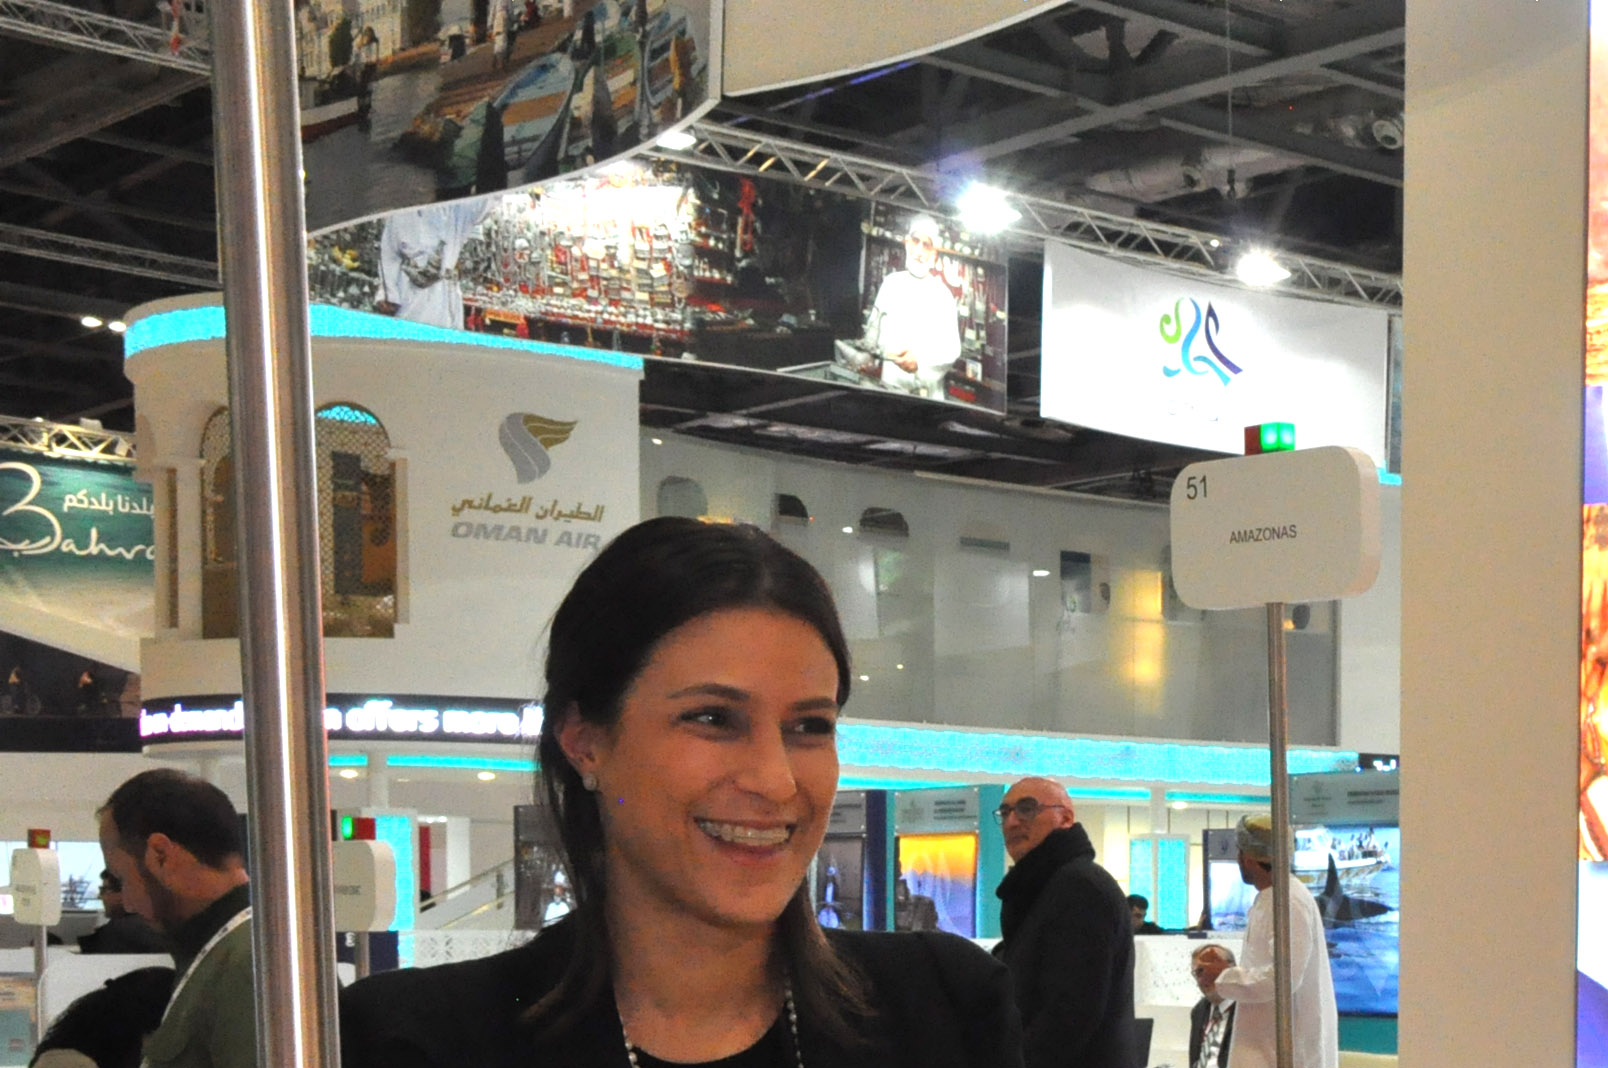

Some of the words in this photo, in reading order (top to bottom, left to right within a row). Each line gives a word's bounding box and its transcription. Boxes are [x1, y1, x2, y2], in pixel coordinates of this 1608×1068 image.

[1186, 475, 1208, 500] 51
[451, 521, 549, 545] OMAN
[554, 530, 603, 550] AIR
[1229, 524, 1297, 545] AMAZONAS
